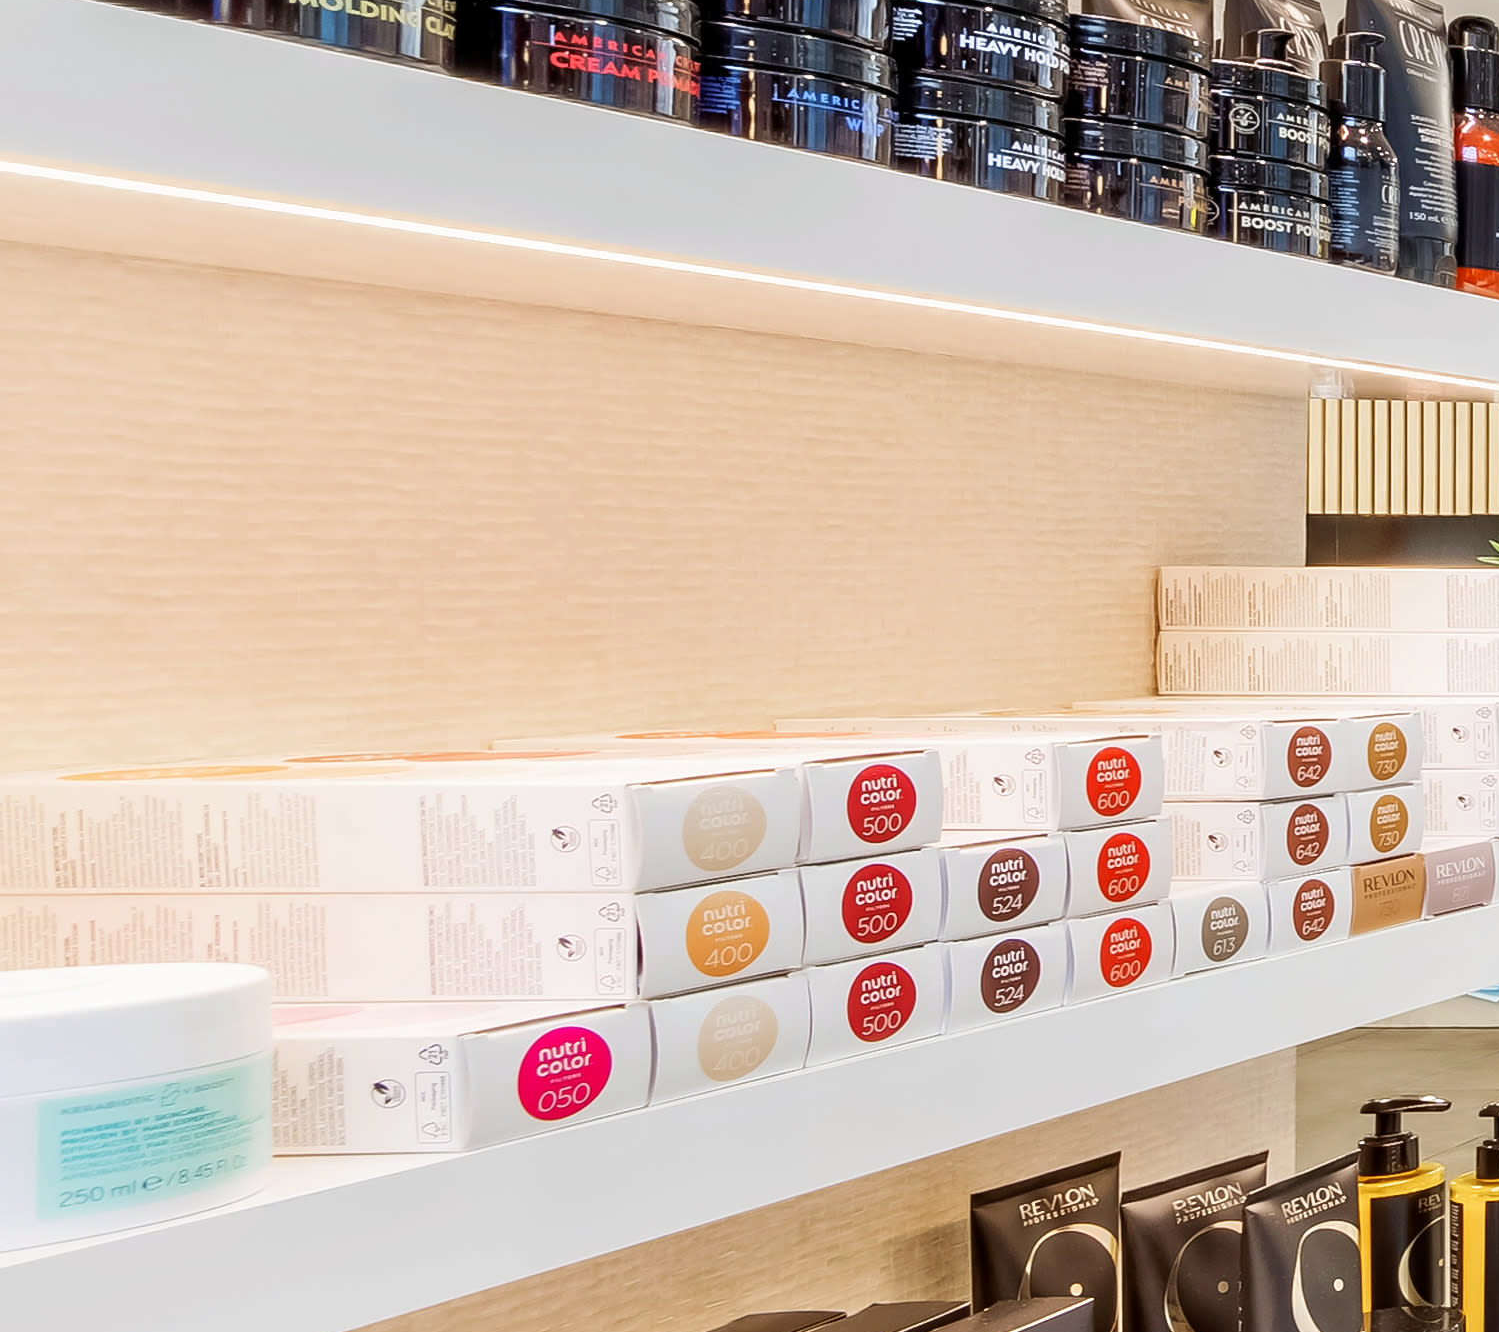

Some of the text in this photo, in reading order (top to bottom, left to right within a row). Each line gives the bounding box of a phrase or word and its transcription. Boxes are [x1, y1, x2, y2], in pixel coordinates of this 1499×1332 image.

[960, 34, 1021, 61] HEAVY
[1399, 19, 1447, 66] CREW
[550, 51, 640, 80] CREAM
[987, 152, 1039, 173] HEAVY
[1239, 200, 1310, 219] AMERICAN
[1409, 211, 1426, 222] 150
[1241, 216, 1292, 234] BOOST
[1295, 732, 1321, 748] nutri
[1295, 743, 1323, 758] color
[1097, 757, 1128, 773] nutri
[1296, 764, 1322, 782] 642
[862, 774, 898, 792] nutri
[1096, 769, 1130, 784] color
[860, 786, 904, 805] color
[1097, 790, 1130, 810] 600
[862, 814, 902, 836] 500
[990, 857, 1024, 874] nutri
[1436, 856, 1486, 879] REVLON
[855, 873, 893, 892] nutri
[989, 869, 1028, 884] color
[1364, 870, 1416, 894] REVLON
[855, 886, 898, 904] color
[992, 893, 1023, 915] 524
[702, 901, 746, 921] nutri
[1210, 905, 1237, 922] nutri
[703, 915, 751, 934] color
[857, 912, 898, 936] 500
[1211, 916, 1239, 930] color
[704, 942, 753, 966] 400
[1213, 936, 1236, 955] 613
[993, 948, 1025, 965] nutri
[992, 960, 1029, 977] color
[861, 971, 898, 990] nutri
[860, 984, 902, 1002] color
[994, 984, 1025, 1007] 524
[862, 1011, 902, 1034] 500
[538, 1038, 587, 1063] nutri
[536, 1050, 593, 1077] color
[538, 1082, 590, 1113] 050
[59, 1186, 105, 1208] 250
[1018, 1182, 1098, 1221] REVLON
[1172, 1182, 1243, 1213] REVLON
[1280, 1182, 1343, 1219] REVLON
